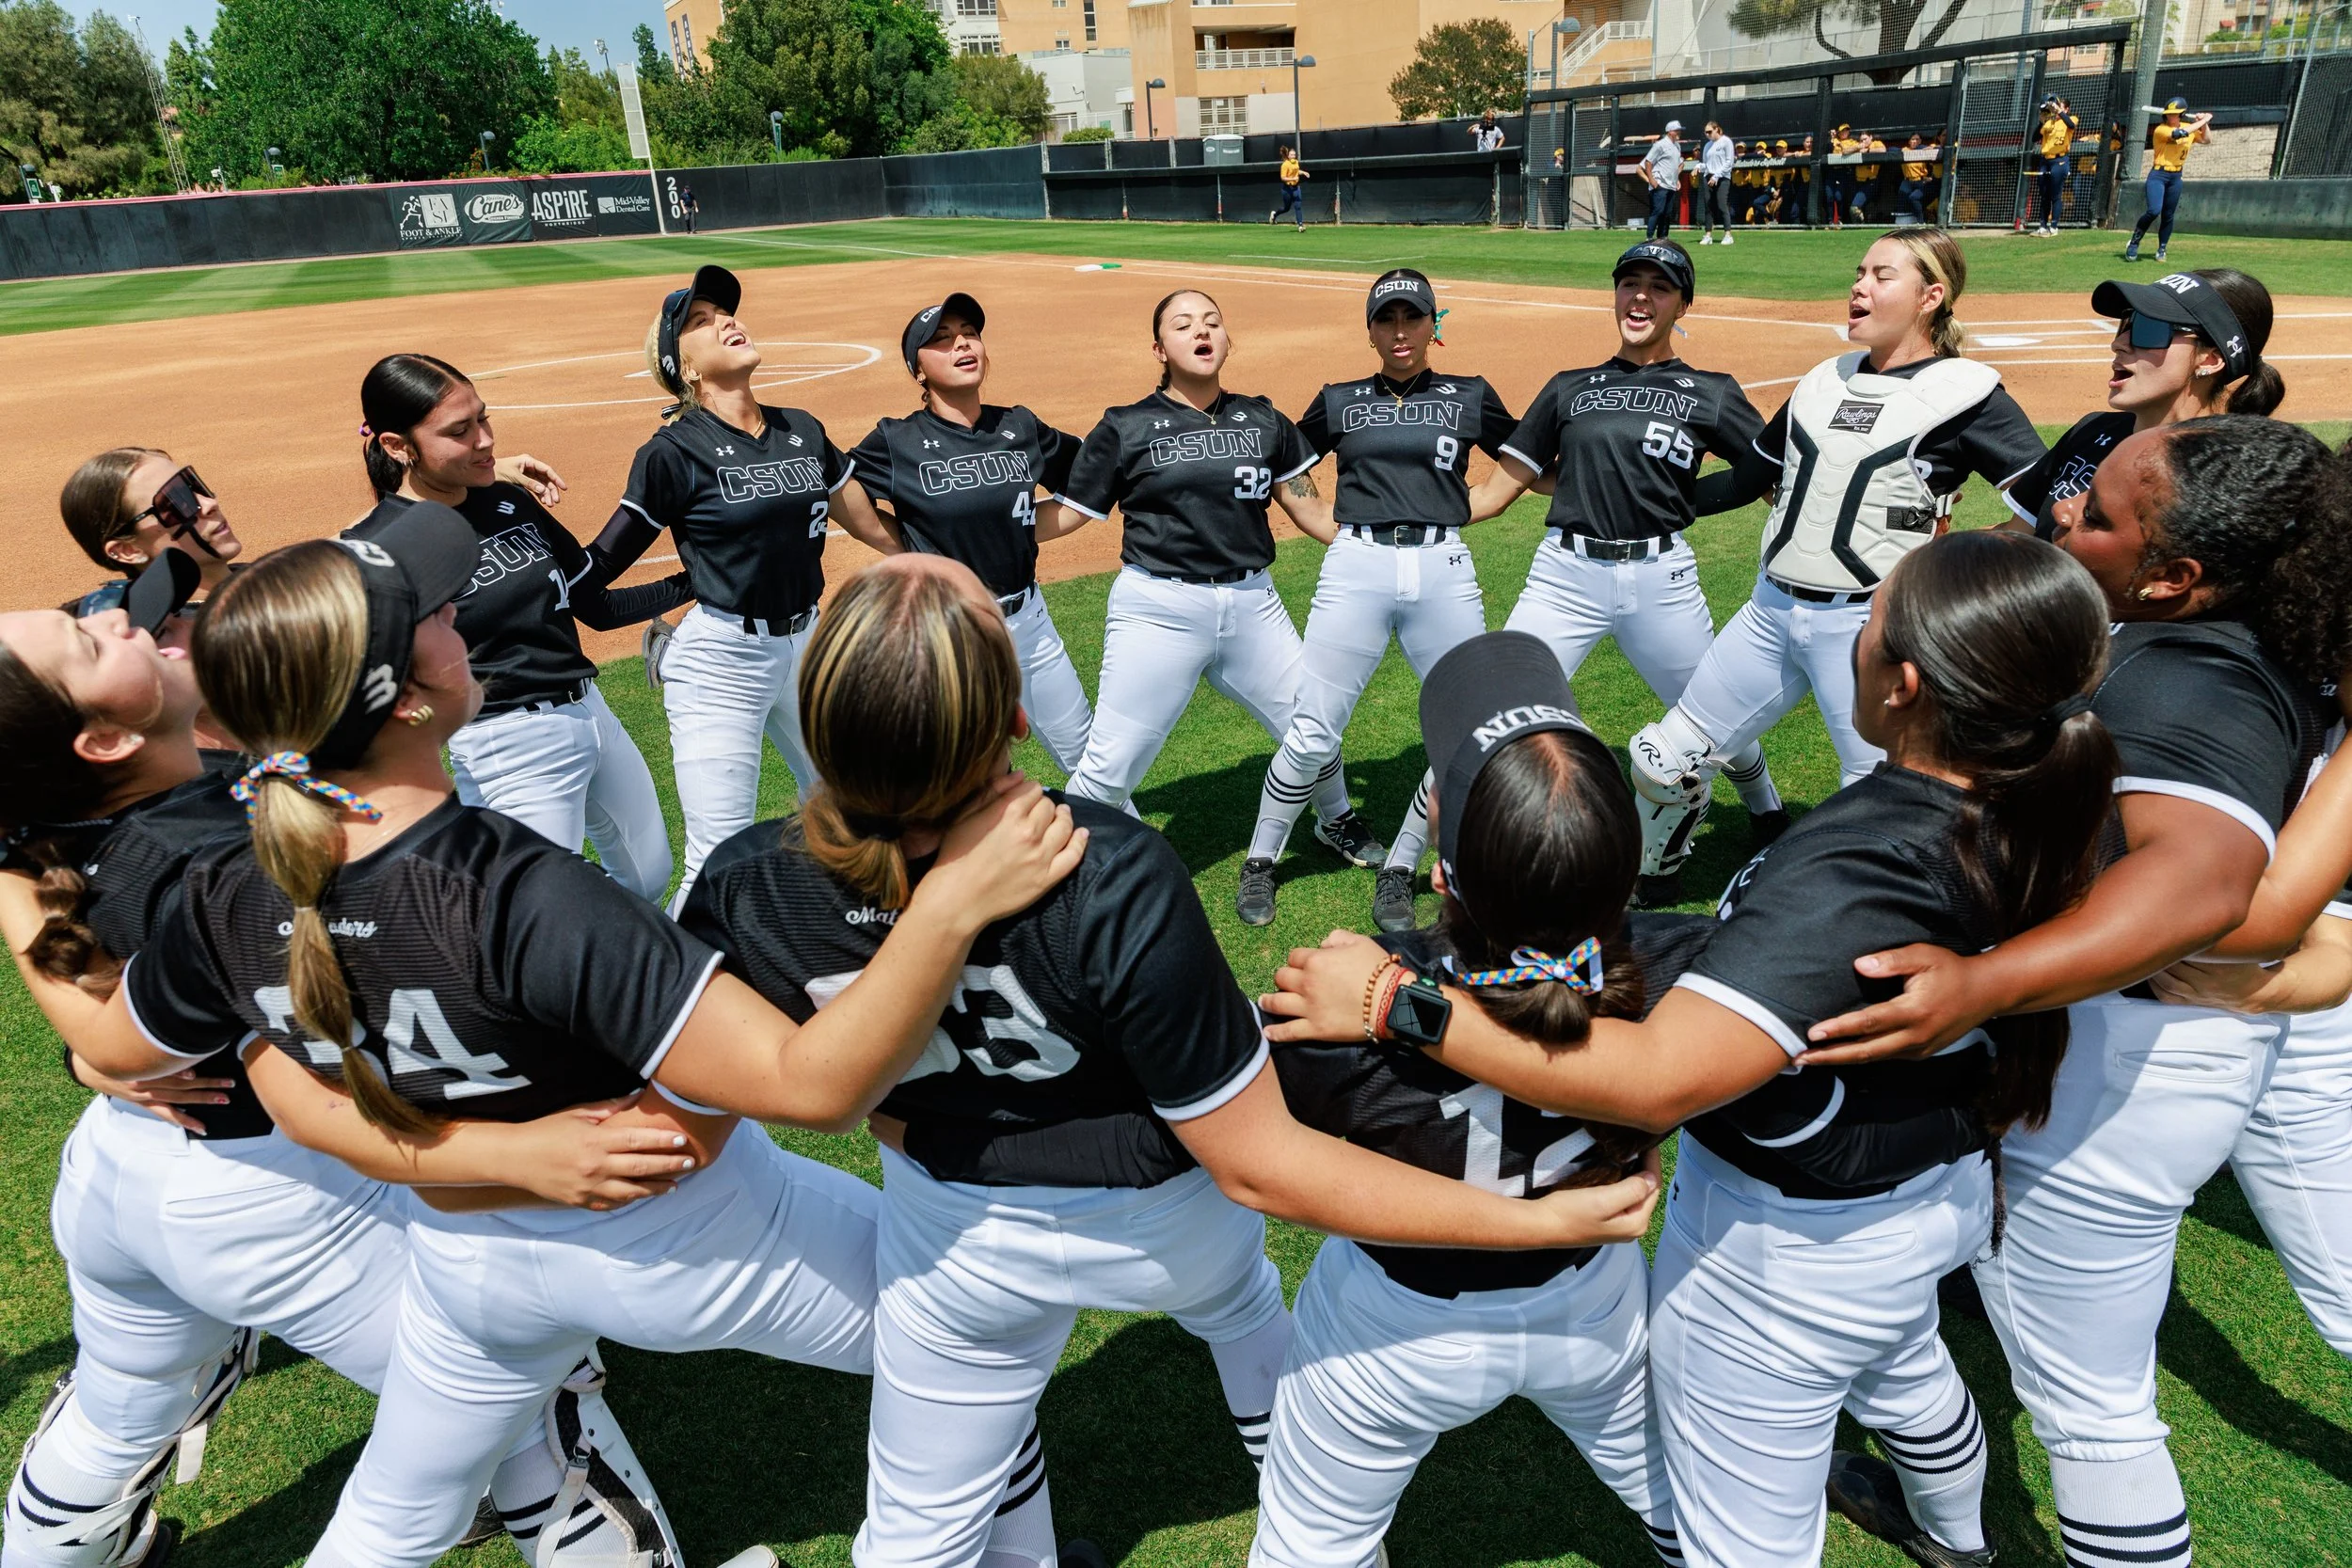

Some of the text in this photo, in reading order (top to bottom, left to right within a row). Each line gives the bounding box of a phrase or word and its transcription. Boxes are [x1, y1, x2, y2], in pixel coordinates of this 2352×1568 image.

[614, 196, 651, 206] Mid-Valley
[400, 229, 424, 238] FOOT
[425, 227, 434, 236] &
[434, 226, 463, 236] ANKLE
[1375, 280, 1419, 298] CSUN
[1343, 401, 1462, 433] CSUN
[1571, 386, 1698, 421] CSUN
[1836, 407, 1877, 423] Rawlings
[1150, 428, 1263, 467] CSUN
[1435, 436, 1458, 470] 9
[1642, 420, 1694, 469] 55
[717, 456, 829, 504] CSUN
[919, 451, 1033, 496] CSUN
[1234, 466, 1272, 499] 32
[452, 523, 553, 601] SUN
